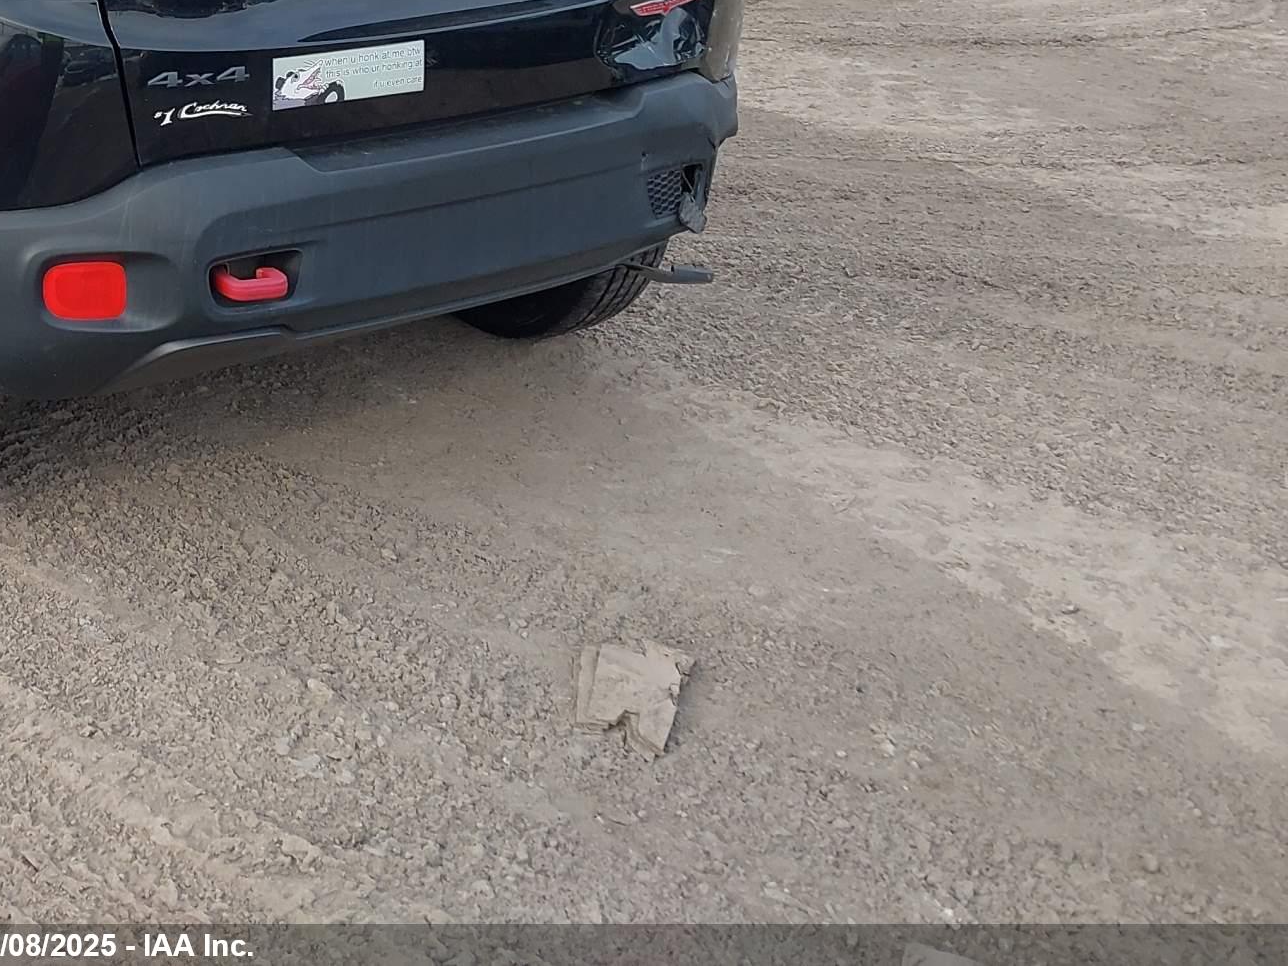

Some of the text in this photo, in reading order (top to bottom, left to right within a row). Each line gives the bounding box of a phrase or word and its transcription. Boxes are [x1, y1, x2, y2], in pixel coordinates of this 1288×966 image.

[325, 56, 347, 67] when
[358, 52, 379, 62] honk
[382, 50, 391, 60] at
[392, 49, 405, 58] me
[326, 58, 422, 78] this is who ur honking at
[147, 65, 250, 88] 4x4
